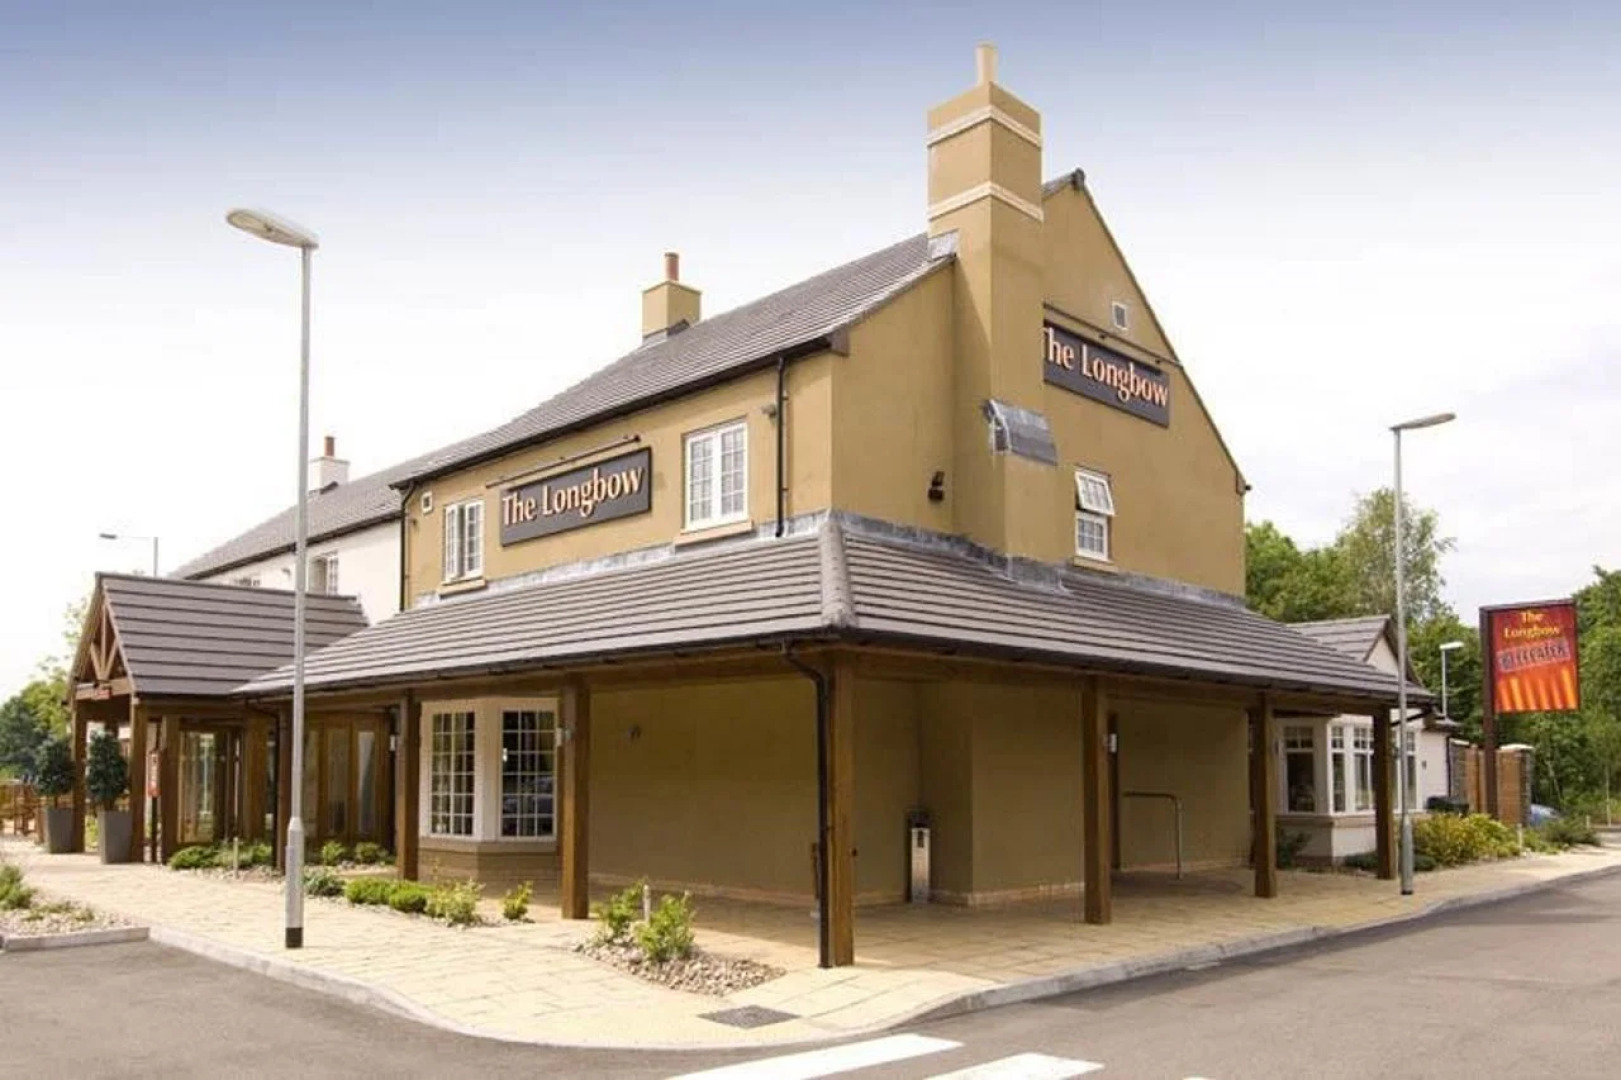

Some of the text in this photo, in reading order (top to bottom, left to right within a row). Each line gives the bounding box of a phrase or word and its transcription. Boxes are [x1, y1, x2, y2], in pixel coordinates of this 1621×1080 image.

[1082, 344, 1168, 407] Longbow
[502, 467, 643, 525] The Longbow
[1503, 624, 1560, 639] Longbow
[1520, 610, 1544, 624] The
